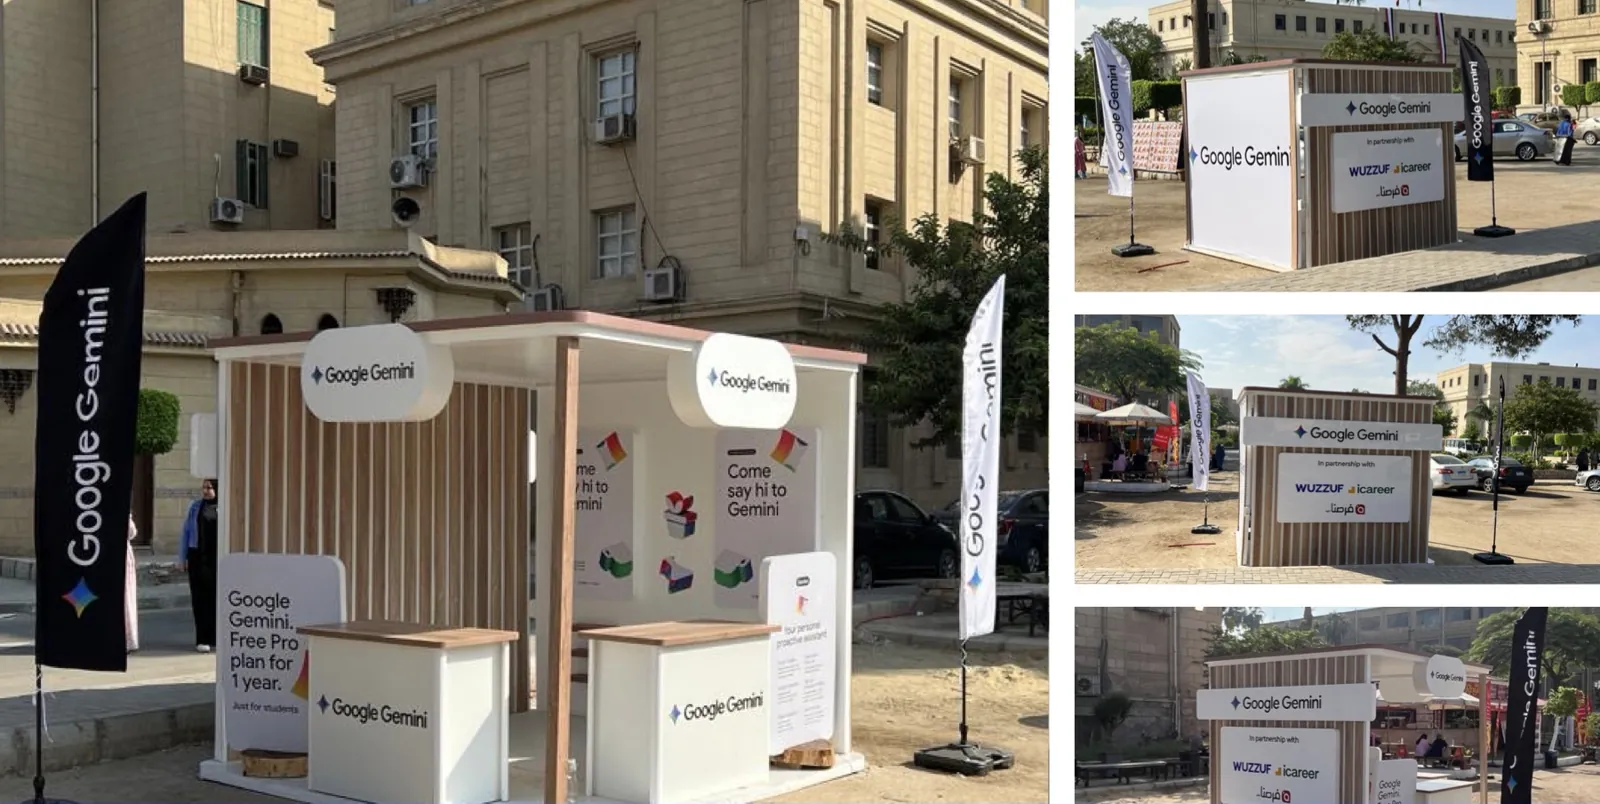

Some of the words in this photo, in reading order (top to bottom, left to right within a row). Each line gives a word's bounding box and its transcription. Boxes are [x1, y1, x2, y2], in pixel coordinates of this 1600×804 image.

[1468, 61, 1480, 103] Gemini
[1359, 102, 1396, 117] Google
[1398, 101, 1431, 114] Gemini
[1472, 106, 1485, 149] Google
[1112, 112, 1125, 162] Google
[1374, 137, 1402, 146] partnership
[1200, 145, 1242, 171] Google
[1349, 163, 1391, 177] WUZZUF
[1401, 162, 1431, 173] icareer
[75, 286, 110, 423] Gemini
[325, 365, 368, 386] Google
[370, 362, 415, 381] Gemini
[720, 370, 756, 393] Google
[757, 376, 790, 394] Gemini
[1310, 427, 1355, 443] Google
[1357, 429, 1399, 441] Gemini
[576, 464, 595, 476] me
[727, 463, 771, 479] Come
[1325, 461, 1360, 469] partnership
[582, 479, 592, 493] hi
[596, 480, 608, 493] to
[727, 485, 751, 501] say
[755, 481, 769, 497] hi
[772, 484, 787, 497] to
[1295, 484, 1344, 493] WUZZUF
[1357, 484, 1395, 494] icareer
[68, 429, 111, 567] Google
[576, 496, 602, 511] mini
[727, 502, 779, 517] Gemini
[228, 590, 291, 612] Google
[229, 612, 294, 630] Gemini.
[230, 632, 267, 649] Free
[271, 635, 299, 650] Pro
[231, 654, 265, 671] plan
[269, 656, 293, 670] for
[232, 674, 238, 688] 1
[243, 678, 281, 692] year.
[1435, 671, 1450, 682] Google
[233, 702, 249, 711] Just
[251, 703, 261, 711] for
[264, 704, 299, 714] students
[332, 698, 378, 724] Google
[381, 706, 428, 728] Gemini
[684, 700, 724, 721] Google
[727, 692, 763, 712] Gemini
[1243, 697, 1280, 713] Google
[1282, 695, 1322, 709] Gemini
[1256, 735, 1285, 744] partnership
[1287, 735, 1299, 743] with
[1233, 761, 1272, 774] WUZZUF
[1283, 765, 1319, 779] icareer
[1379, 779, 1401, 790] Google
